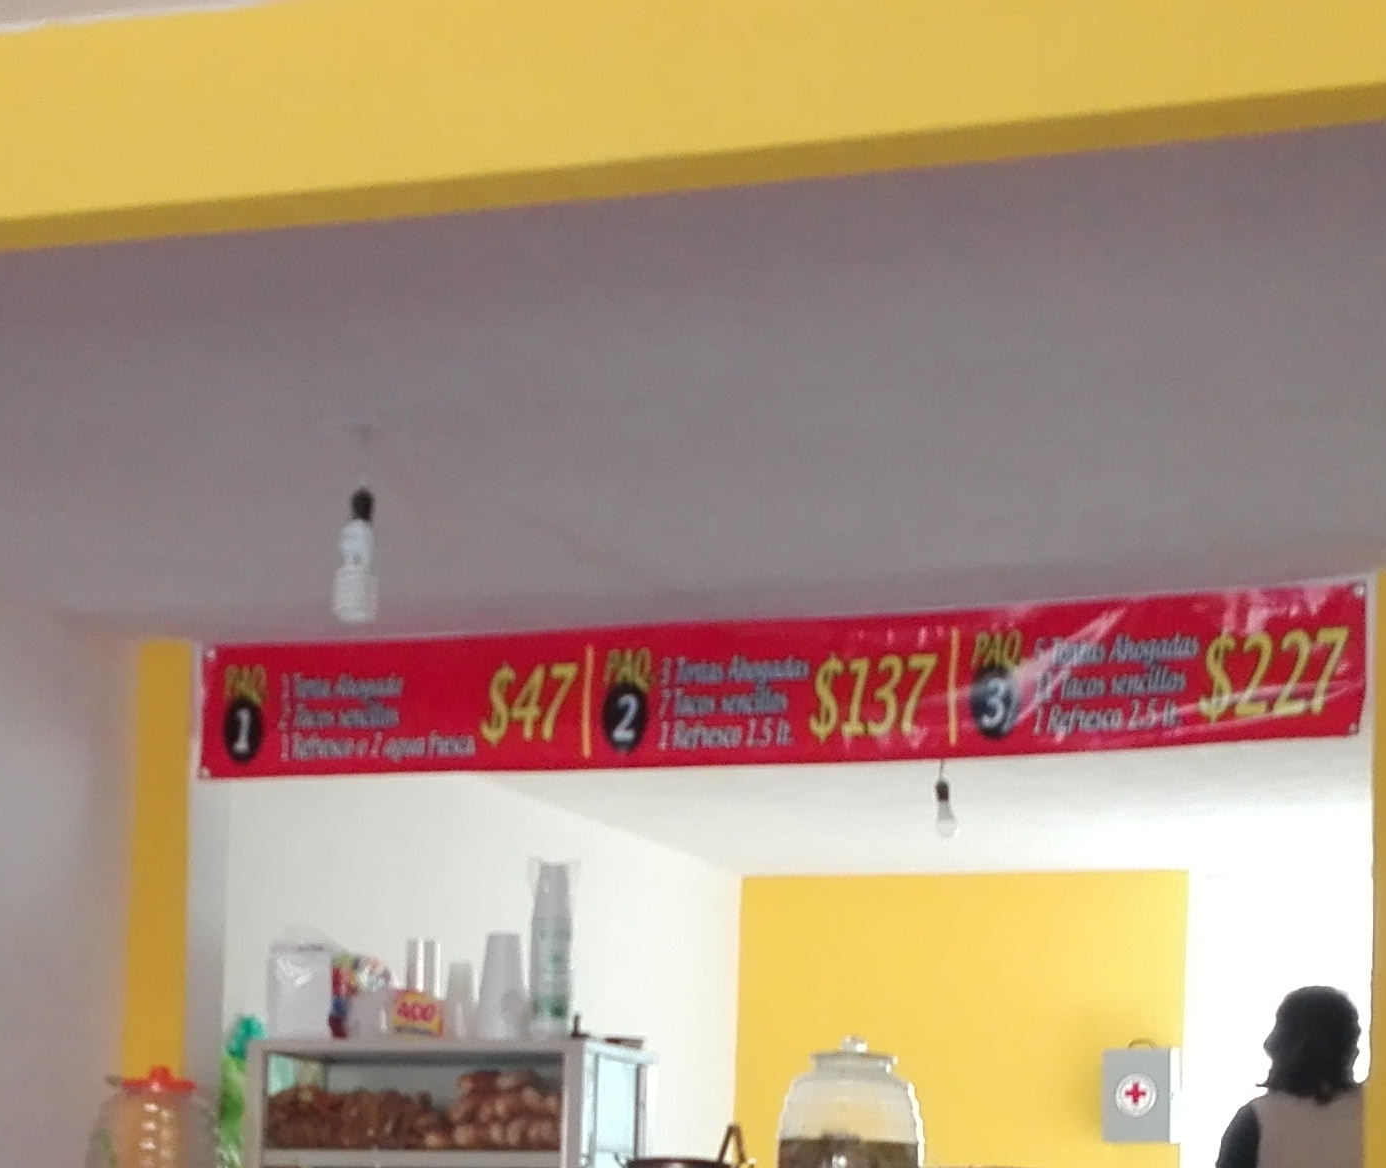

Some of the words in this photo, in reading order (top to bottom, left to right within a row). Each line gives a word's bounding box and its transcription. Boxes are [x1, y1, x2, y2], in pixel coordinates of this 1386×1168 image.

[603, 648, 652, 693] PAQ
[676, 656, 724, 684] Tortas
[728, 655, 810, 686] Ahogadas
[970, 629, 1023, 672] PAQ
[1050, 634, 1107, 666] Tortas
[1109, 631, 1200, 668] Ahogadas
[1060, 667, 1106, 700] Tacos
[1111, 664, 1187, 696] sencillos
[1197, 626, 1350, 725] $227
[480, 662, 578, 747] $47
[613, 693, 638, 742] 2
[674, 688, 716, 717] Tacos
[720, 684, 789, 715] sencillos
[809, 652, 939, 743] $137
[982, 677, 1008, 729] 3
[1033, 704, 1043, 735] 1
[1047, 703, 1123, 737] Refresco
[1127, 697, 1158, 731] 2.5
[234, 708, 251, 752] 1
[293, 731, 355, 760] Refresco
[673, 720, 743, 751] Refresco
[746, 717, 774, 748] 1.5
